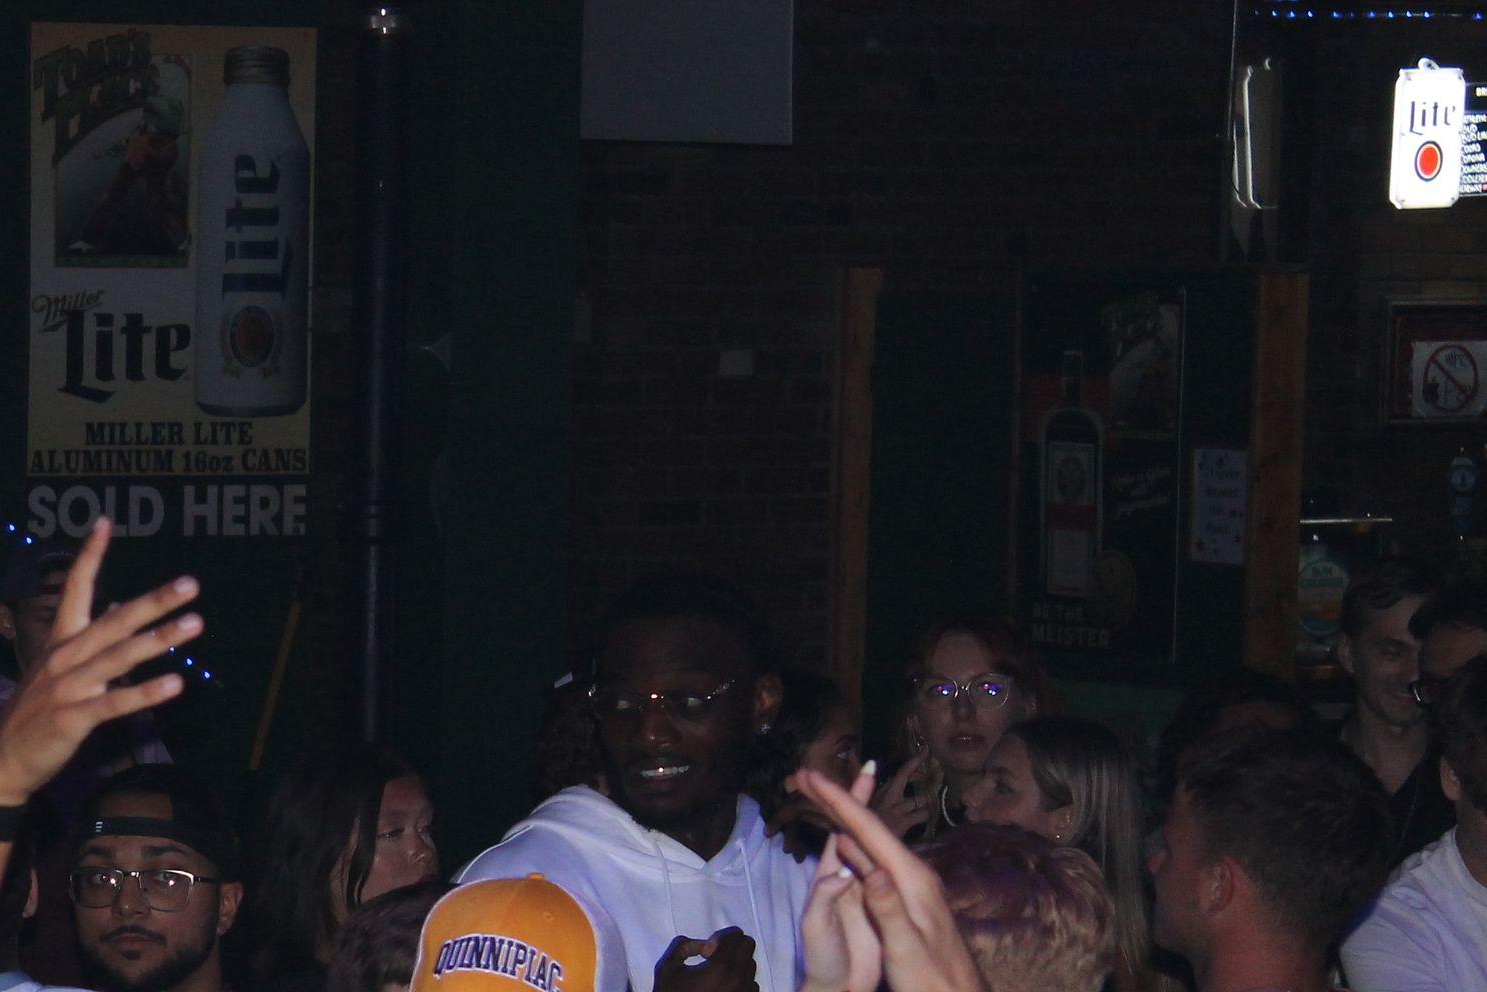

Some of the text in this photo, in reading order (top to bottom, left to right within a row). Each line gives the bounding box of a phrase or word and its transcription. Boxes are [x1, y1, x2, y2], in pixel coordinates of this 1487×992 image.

[222, 155, 293, 300] Lite
[32, 289, 106, 333] Miller
[58, 310, 191, 402] Lite
[84, 421, 254, 446] MILLER LITE
[30, 447, 308, 474] ALUMINUM 16oz CANS
[26, 484, 308, 540] SOLD HERE
[1031, 622, 1111, 650] MEISTER
